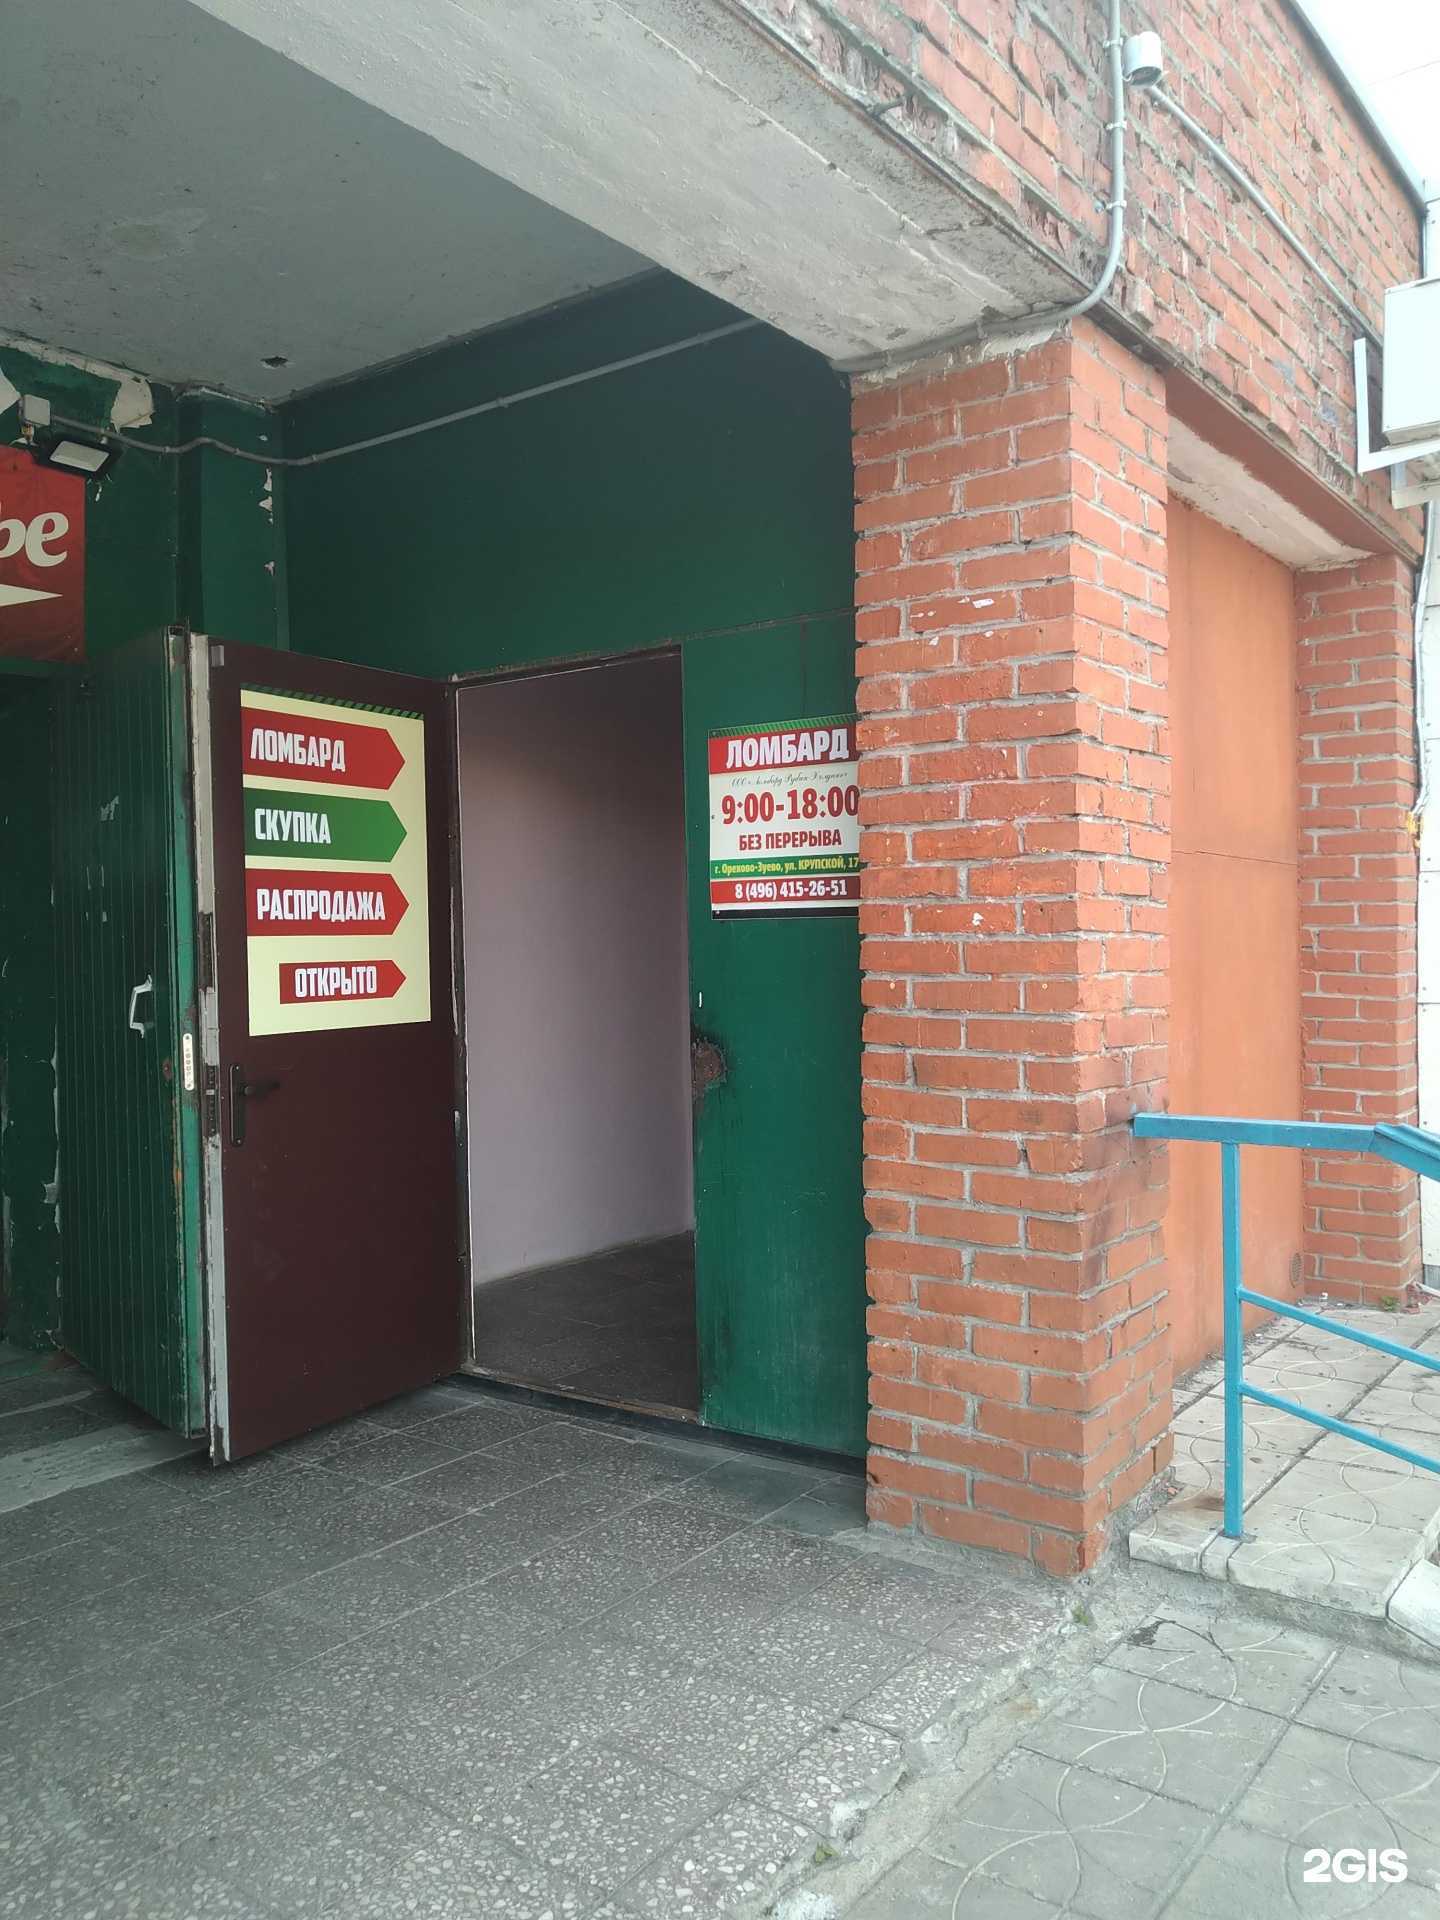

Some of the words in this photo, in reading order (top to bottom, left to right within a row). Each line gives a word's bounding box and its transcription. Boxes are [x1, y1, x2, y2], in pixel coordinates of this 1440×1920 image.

[250, 728, 346, 773] ЛОМБАРД
[726, 728, 849, 769] ЛОМБАРД
[721, 785, 860, 825] 9:00-18:00
[254, 808, 332, 845] СКУПКА
[739, 834, 762, 851] БЕЗ
[765, 829, 842, 850] ПЕРЕРЫВА
[721, 861, 784, 877] Орехово-Зуево,
[784, 862, 797, 875] ул.
[798, 856, 848, 871] КРУПСКОЙ,
[257, 888, 386, 923] РАСПРОДАЖА
[735, 883, 743, 899] 8
[745, 881, 777, 901] (496)
[779, 879, 847, 898] 415-26-51
[294, 965, 377, 998] ОТКРЫТО
